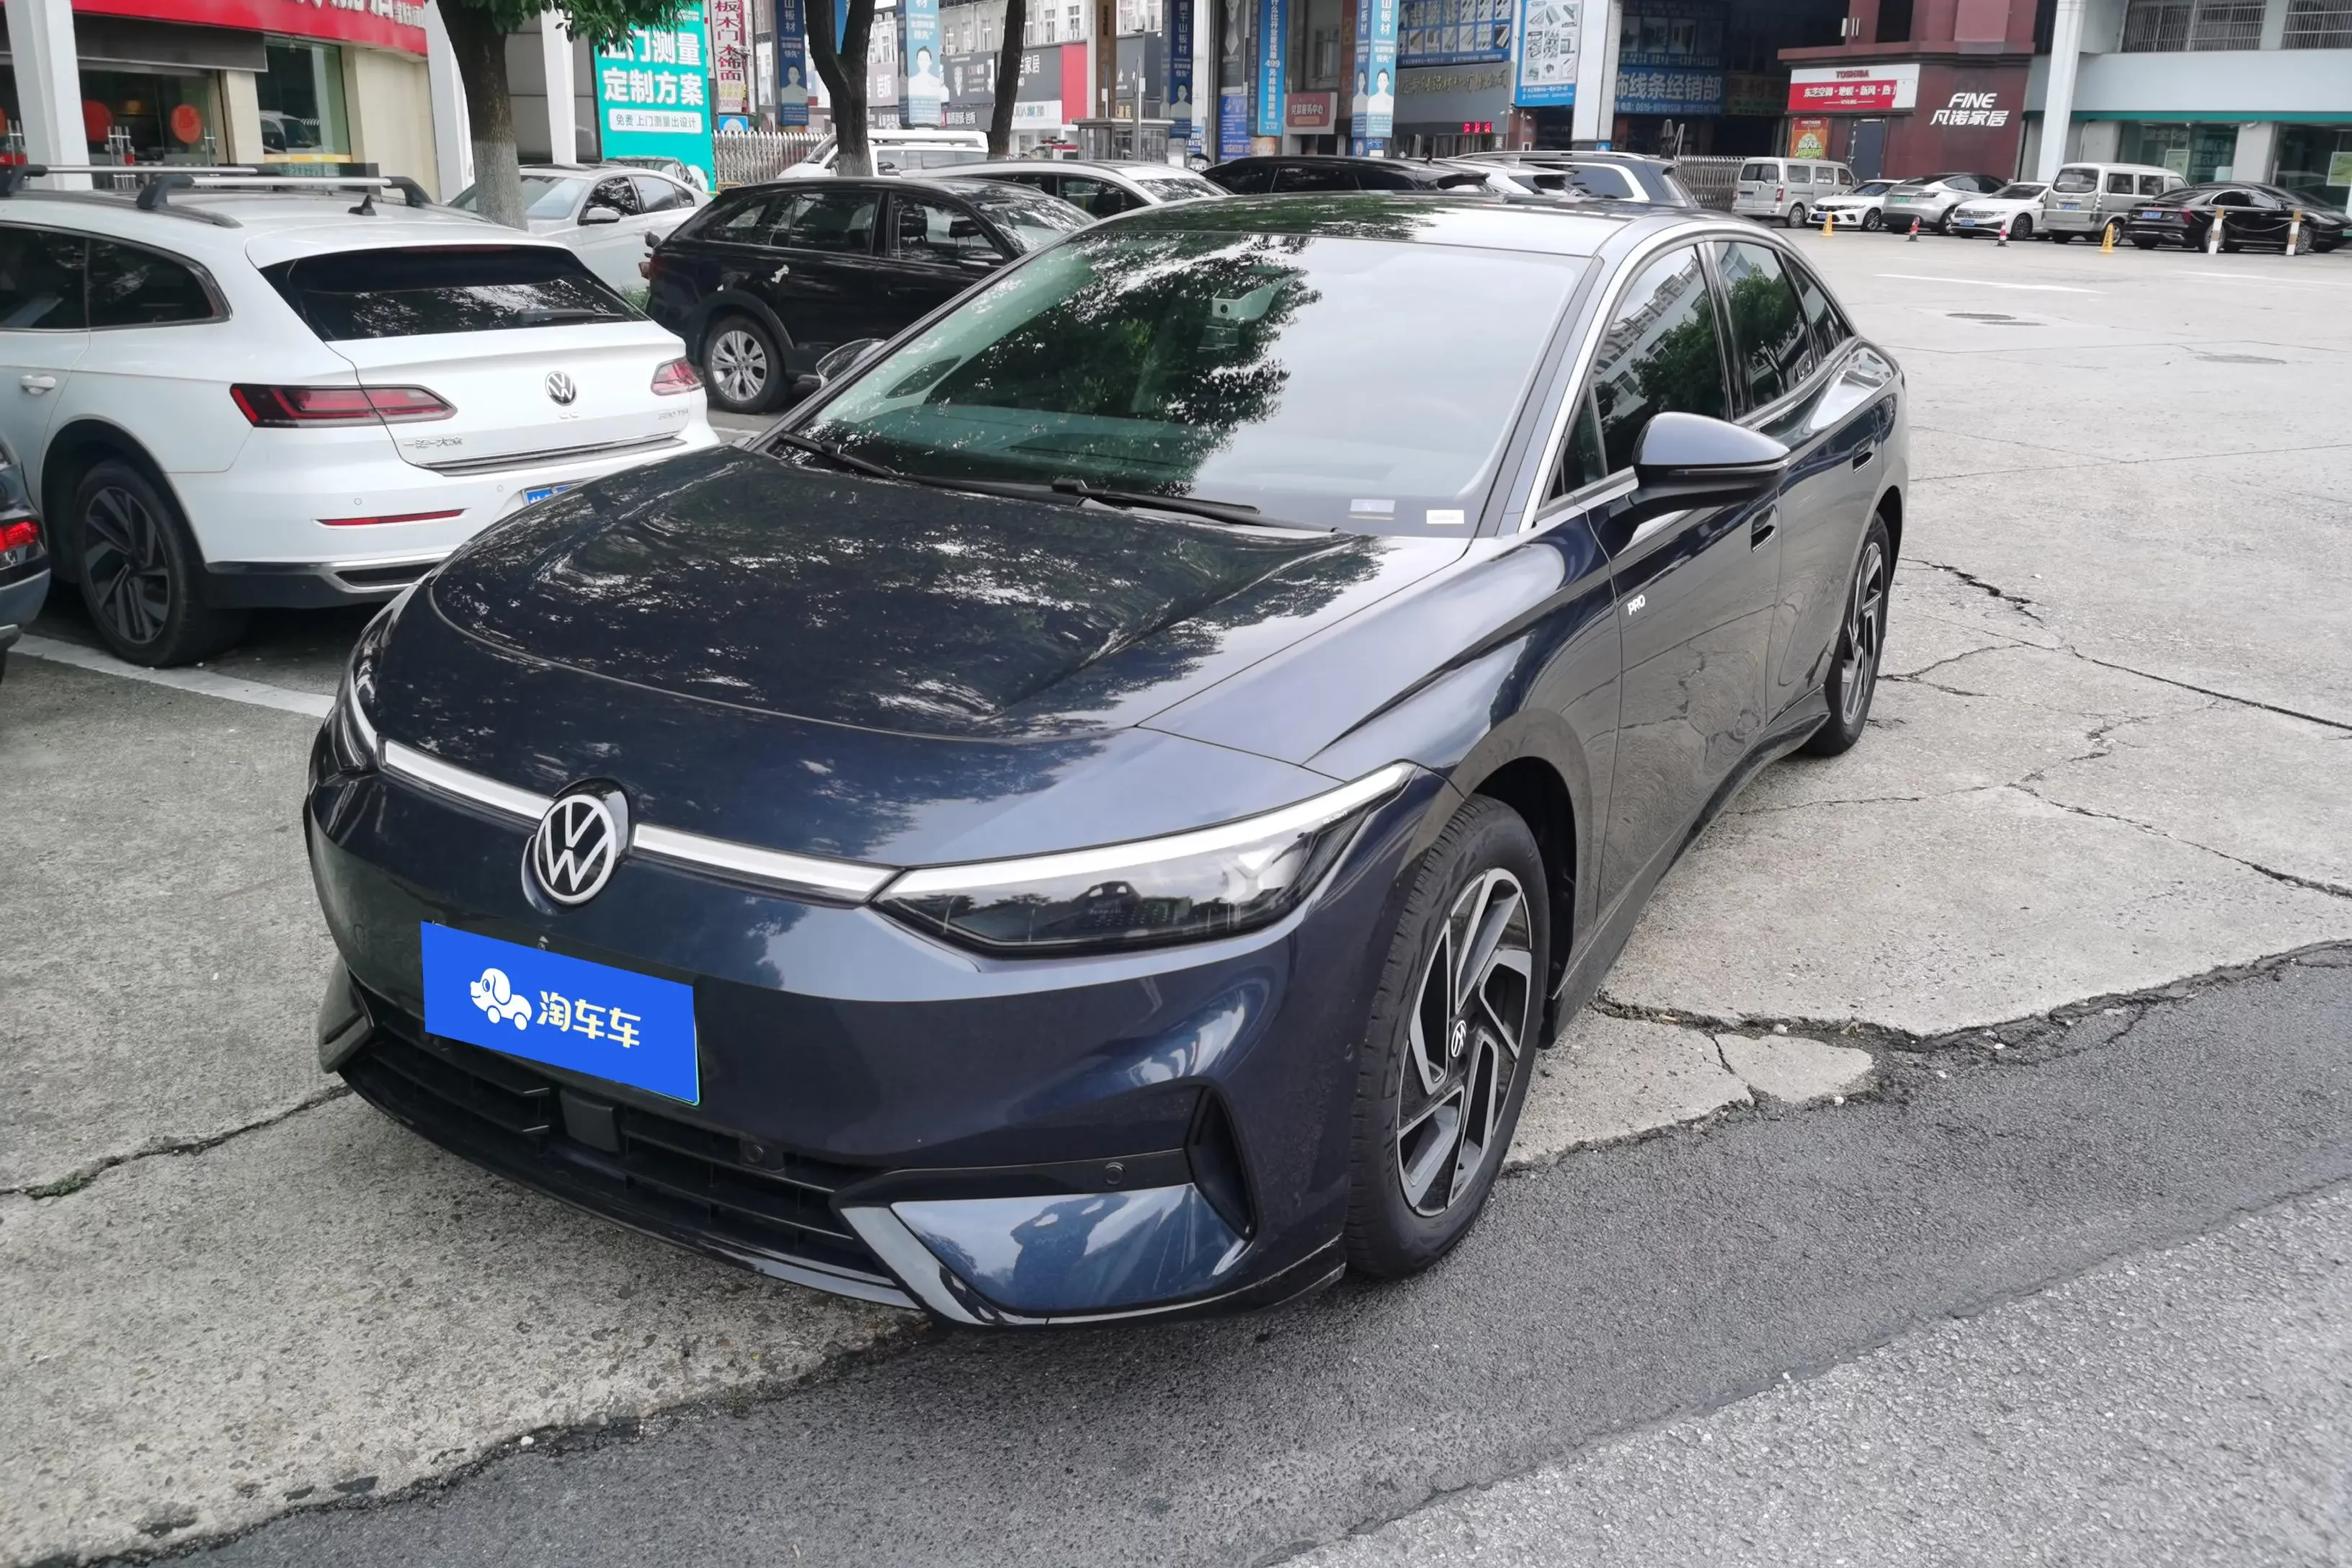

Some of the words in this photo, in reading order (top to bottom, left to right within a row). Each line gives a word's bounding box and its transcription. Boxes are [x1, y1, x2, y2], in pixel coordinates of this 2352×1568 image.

[1836, 70, 1870, 79] TOSHIBA
[602, 67, 704, 106] 定制方案
[1948, 93, 1997, 108] FINE
[616, 114, 634, 127] 免费
[1930, 110, 2010, 127] 凡诺家居
[559, 410, 579, 419] CC
[403, 435, 463, 450] 一汽-大众
[1627, 594, 1646, 615] PRO
